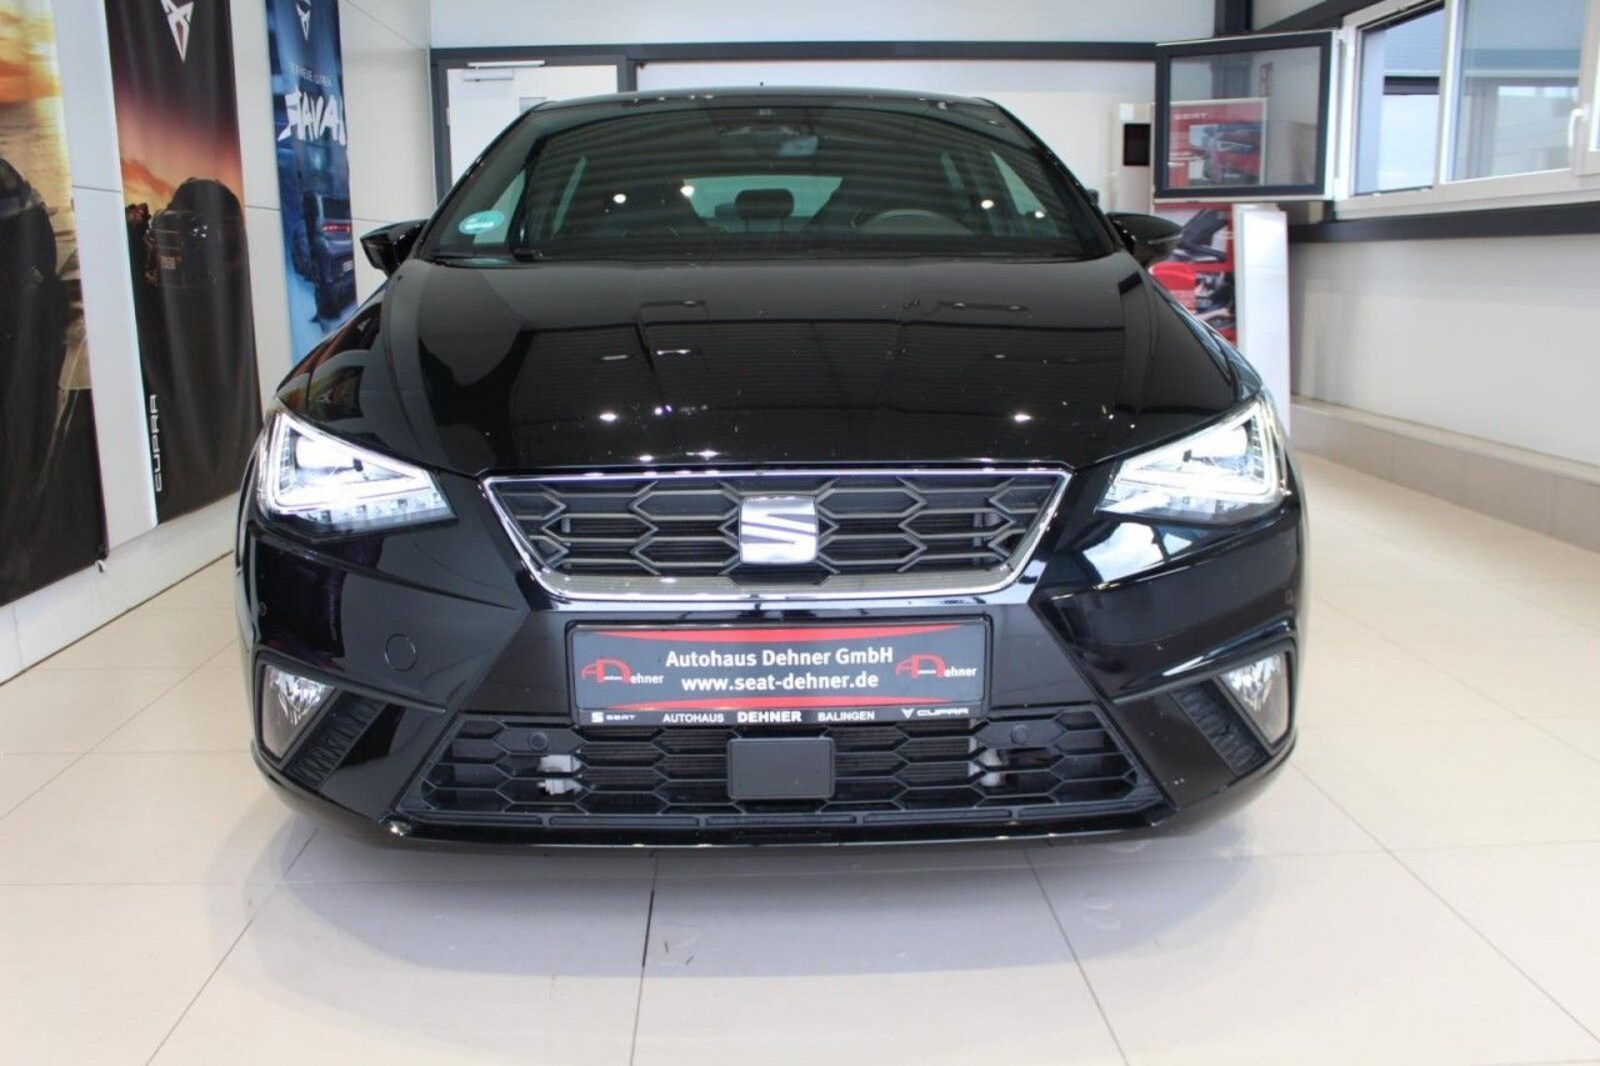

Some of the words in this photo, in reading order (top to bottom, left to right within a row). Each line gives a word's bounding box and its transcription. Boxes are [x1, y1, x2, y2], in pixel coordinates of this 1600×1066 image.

[150, 394, 163, 493] CUPRA
[665, 649, 757, 668] Autohaus
[762, 648, 831, 667] Dehner
[835, 646, 893, 665] GmbH
[681, 670, 879, 692] www.seat-dehner.de
[662, 713, 725, 723] AUTOHAUS
[737, 710, 803, 723] DEHNER
[817, 710, 876, 721] BALINGEN
